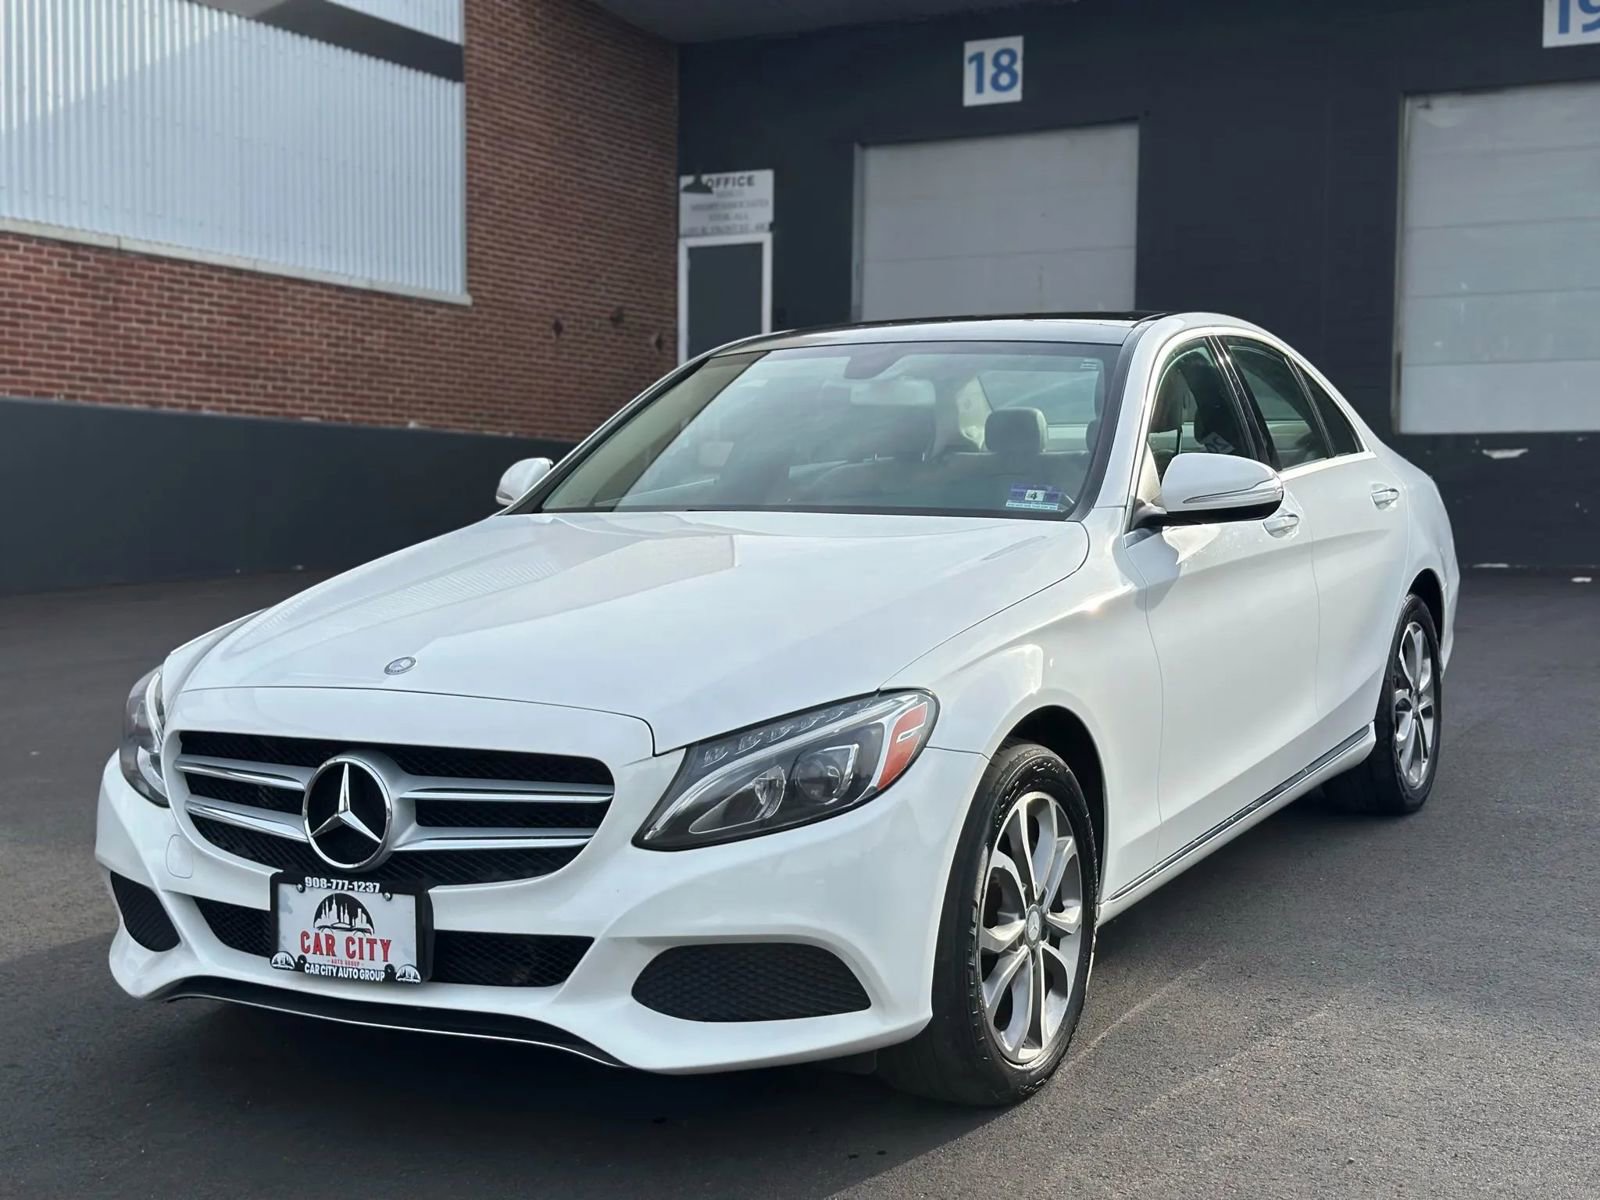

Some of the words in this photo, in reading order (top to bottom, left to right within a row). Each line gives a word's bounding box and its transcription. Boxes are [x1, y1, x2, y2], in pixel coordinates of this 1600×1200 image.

[1558, 0, 1600, 34] 19
[968, 47, 1019, 94] 18
[707, 174, 755, 189] OFFICE
[1031, 491, 1038, 500] 4
[305, 876, 380, 893] 908-777-1237
[300, 930, 337, 957] CAR
[345, 936, 392, 962] CITY
[304, 963, 320, 974] CAR
[320, 965, 338, 977] CITY
[338, 966, 359, 979] AUTO
[359, 968, 386, 982] GROUP
